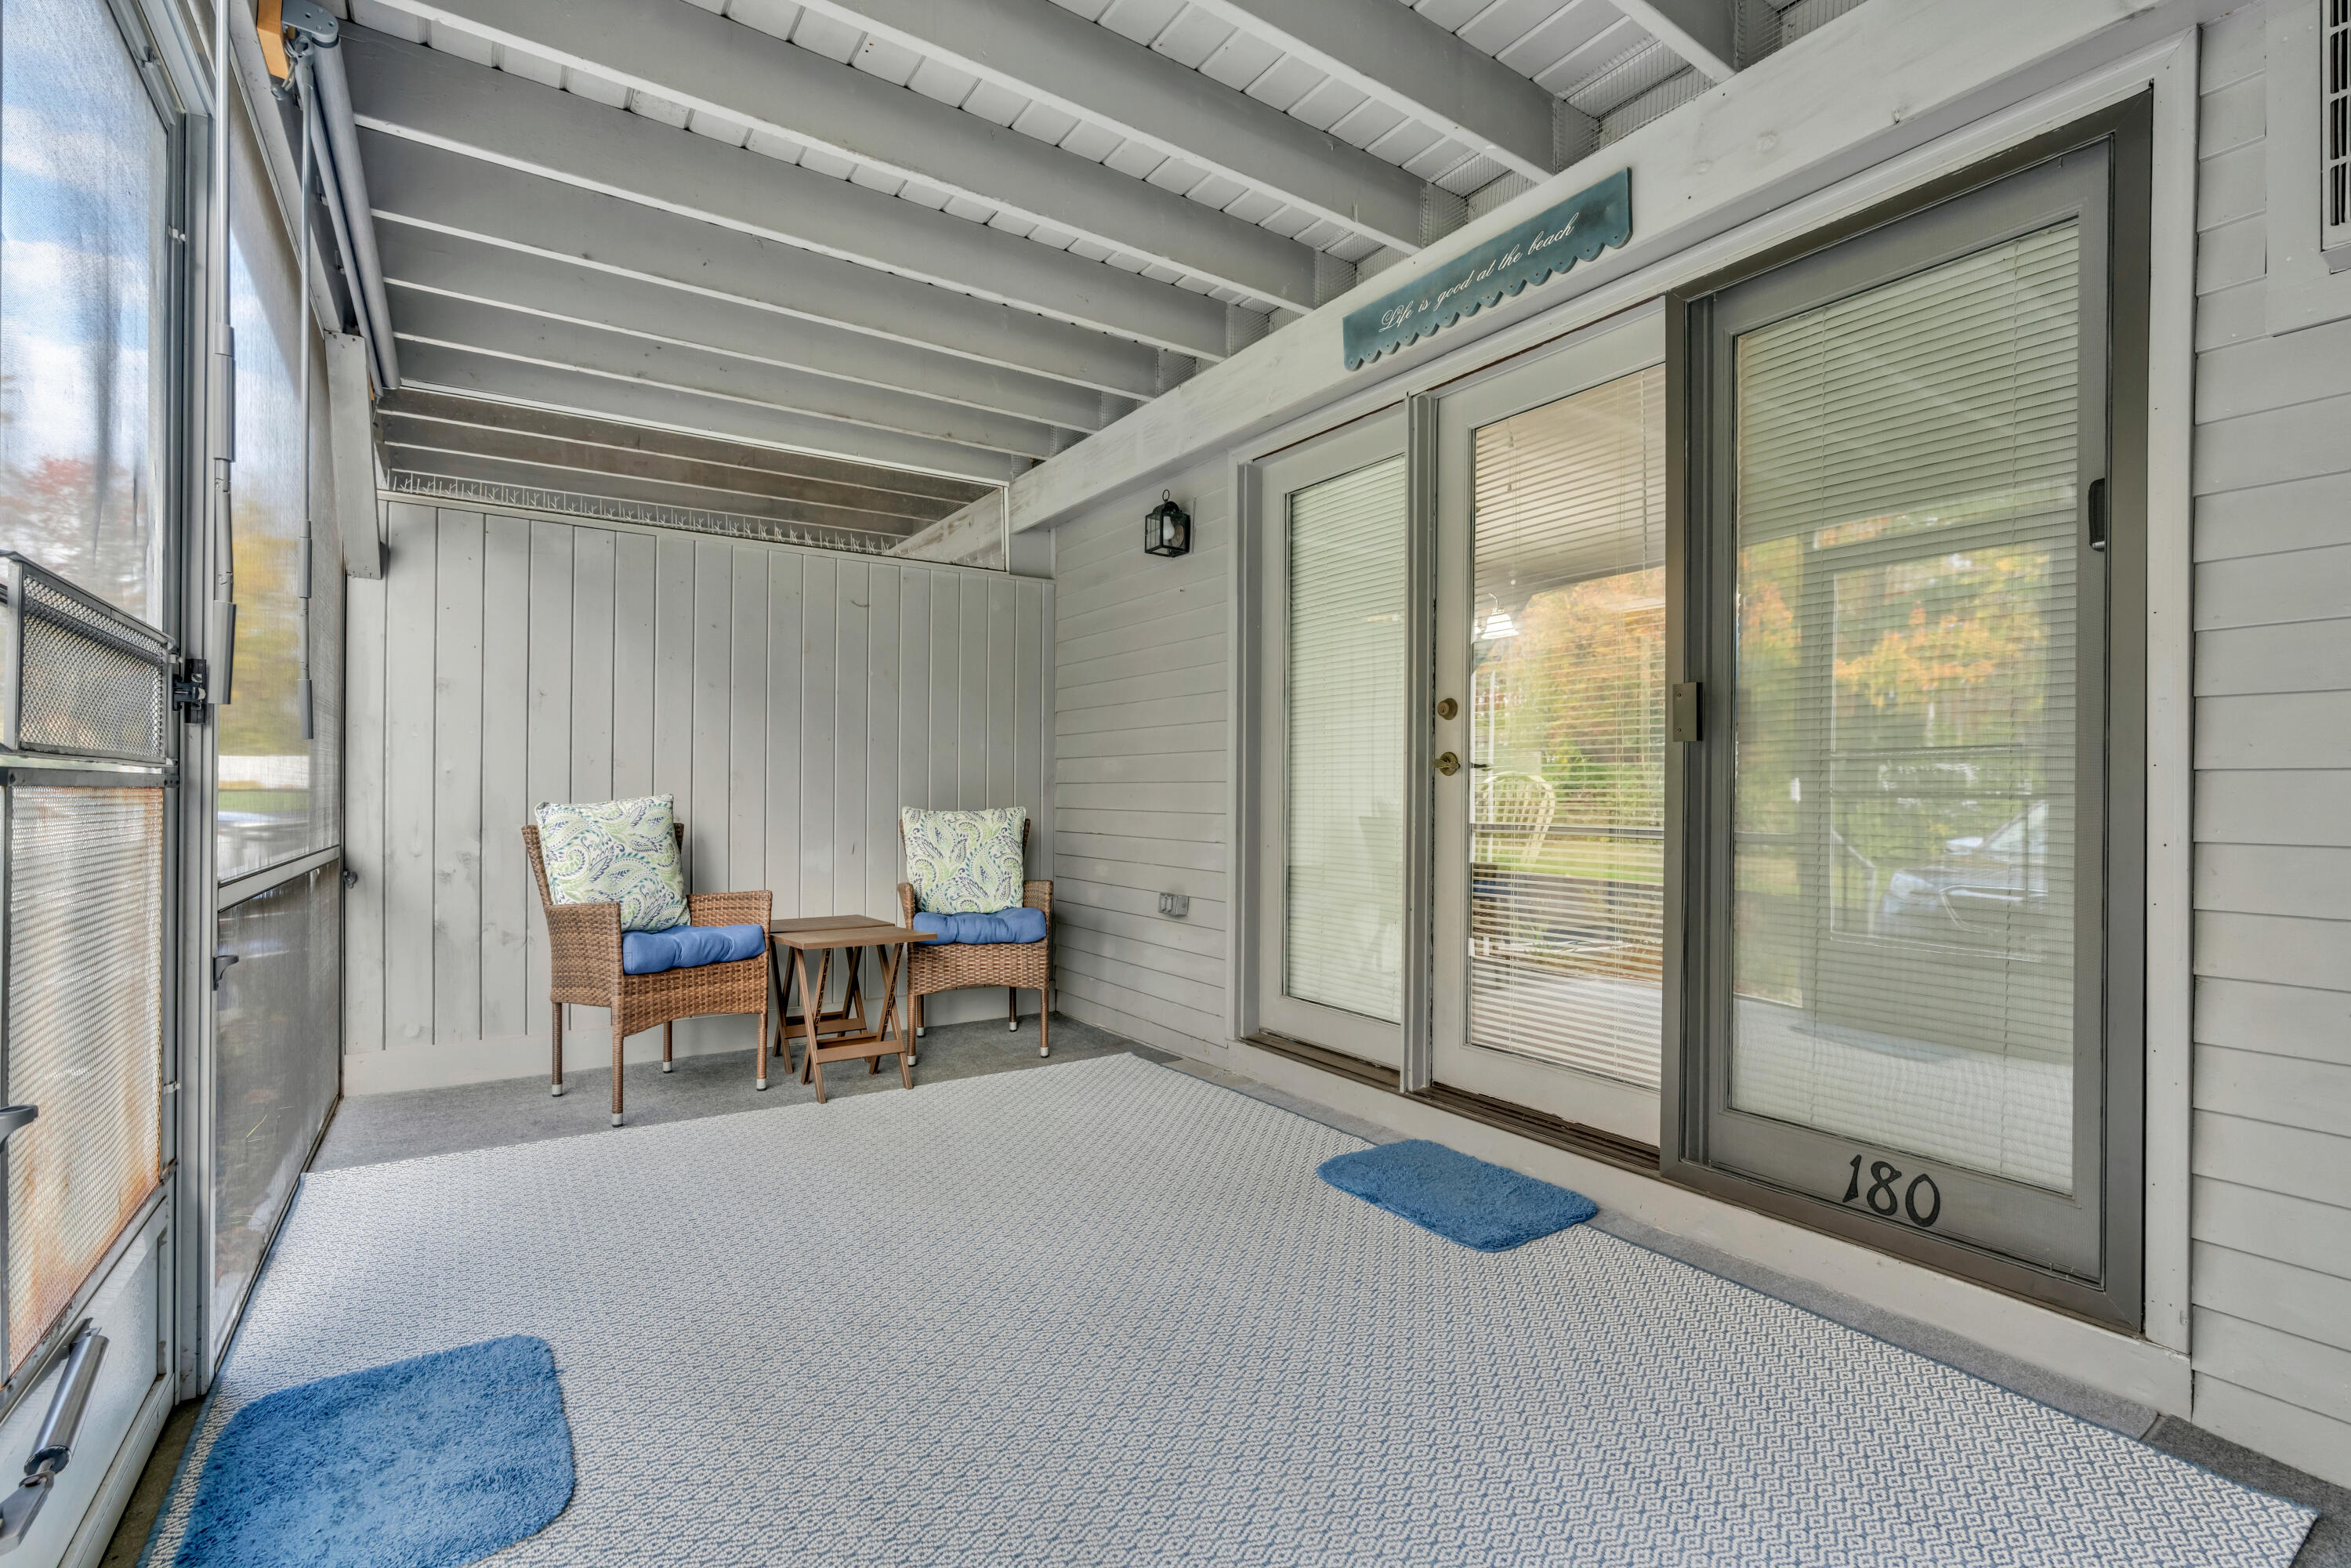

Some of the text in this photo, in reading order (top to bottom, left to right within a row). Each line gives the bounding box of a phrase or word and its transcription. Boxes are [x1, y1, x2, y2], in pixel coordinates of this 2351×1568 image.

[1378, 212, 1579, 333] Life is good at the beach
[1842, 1154, 1940, 1227] 180
